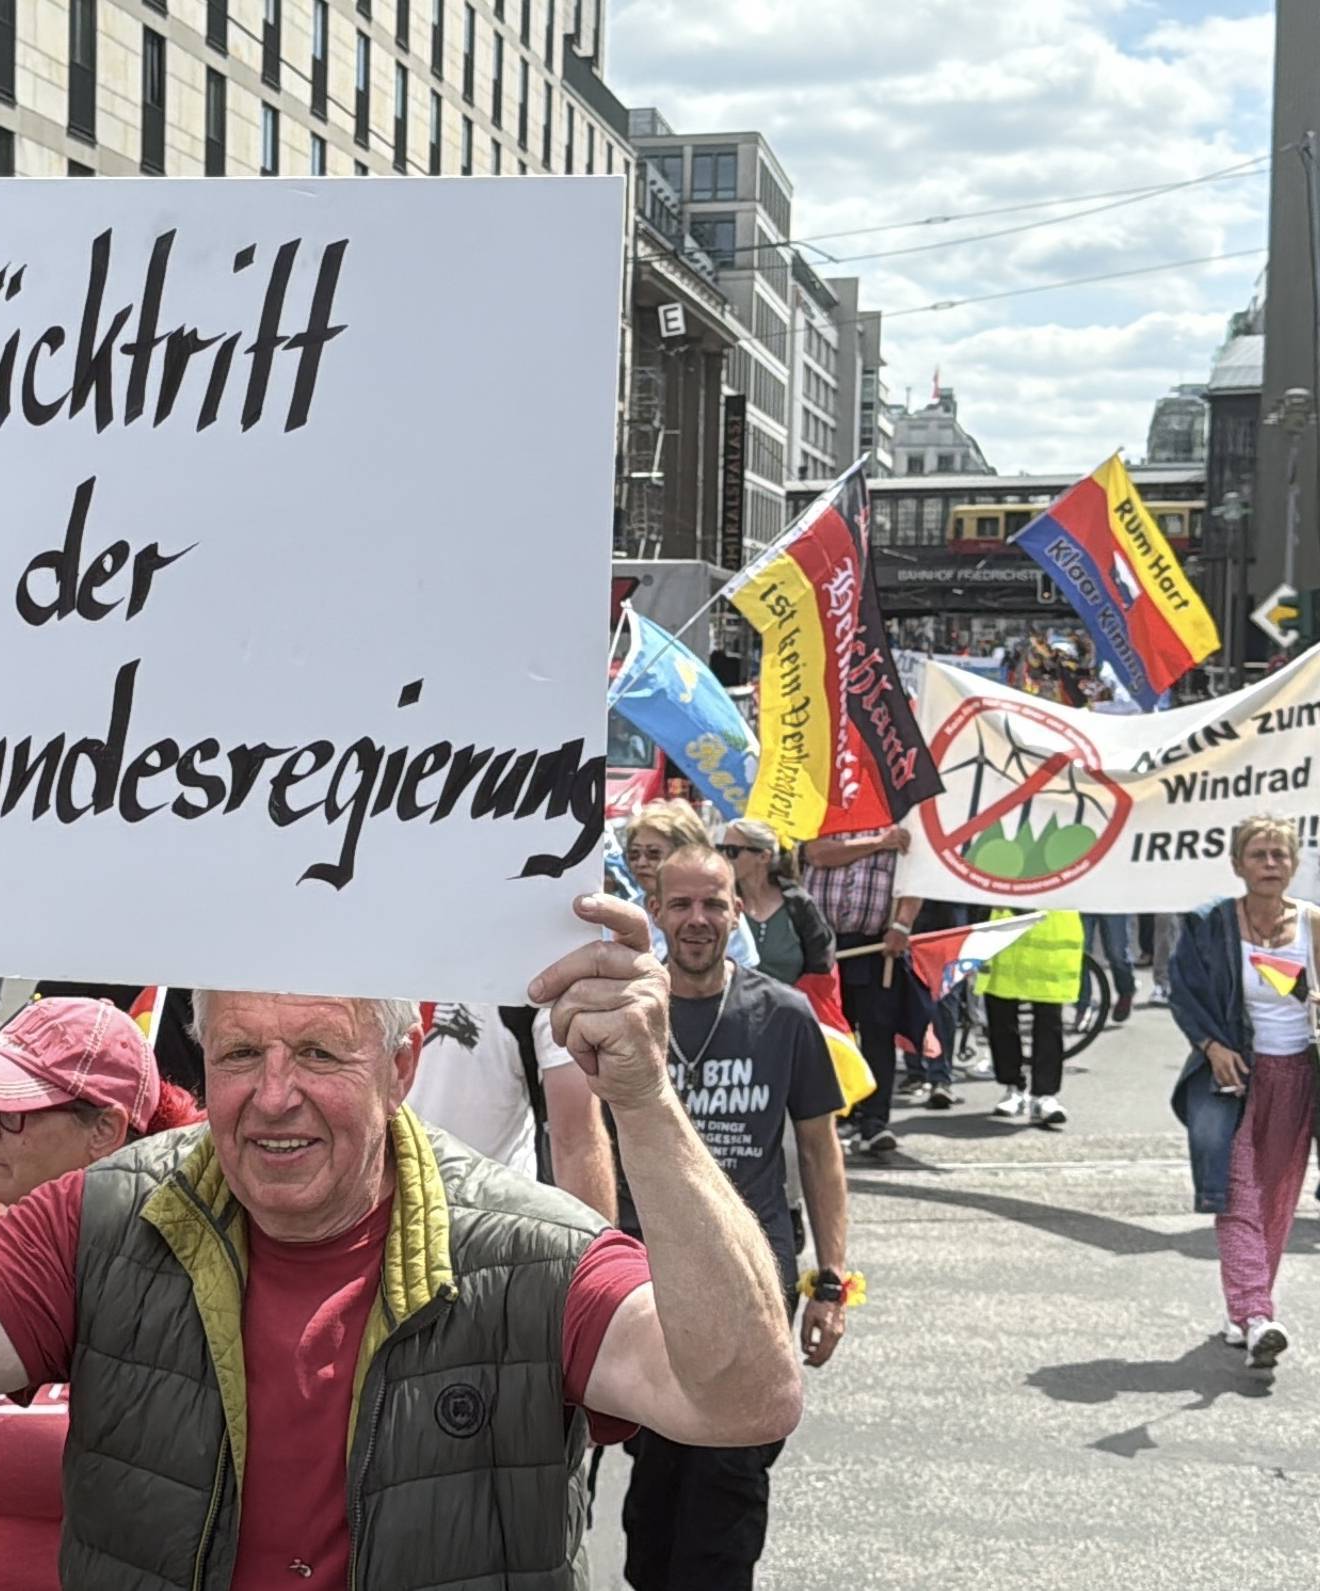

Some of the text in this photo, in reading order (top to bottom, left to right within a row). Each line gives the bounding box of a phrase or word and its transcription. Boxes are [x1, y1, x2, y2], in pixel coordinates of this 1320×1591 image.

[15, 475, 200, 627] der
[1044, 536, 1102, 606] Klaar
[759, 581, 798, 631] ist
[1147, 554, 1190, 611] Hart
[776, 626, 808, 698] kein
[1159, 757, 1312, 804] Windrad
[703, 1057, 753, 1088] BIN
